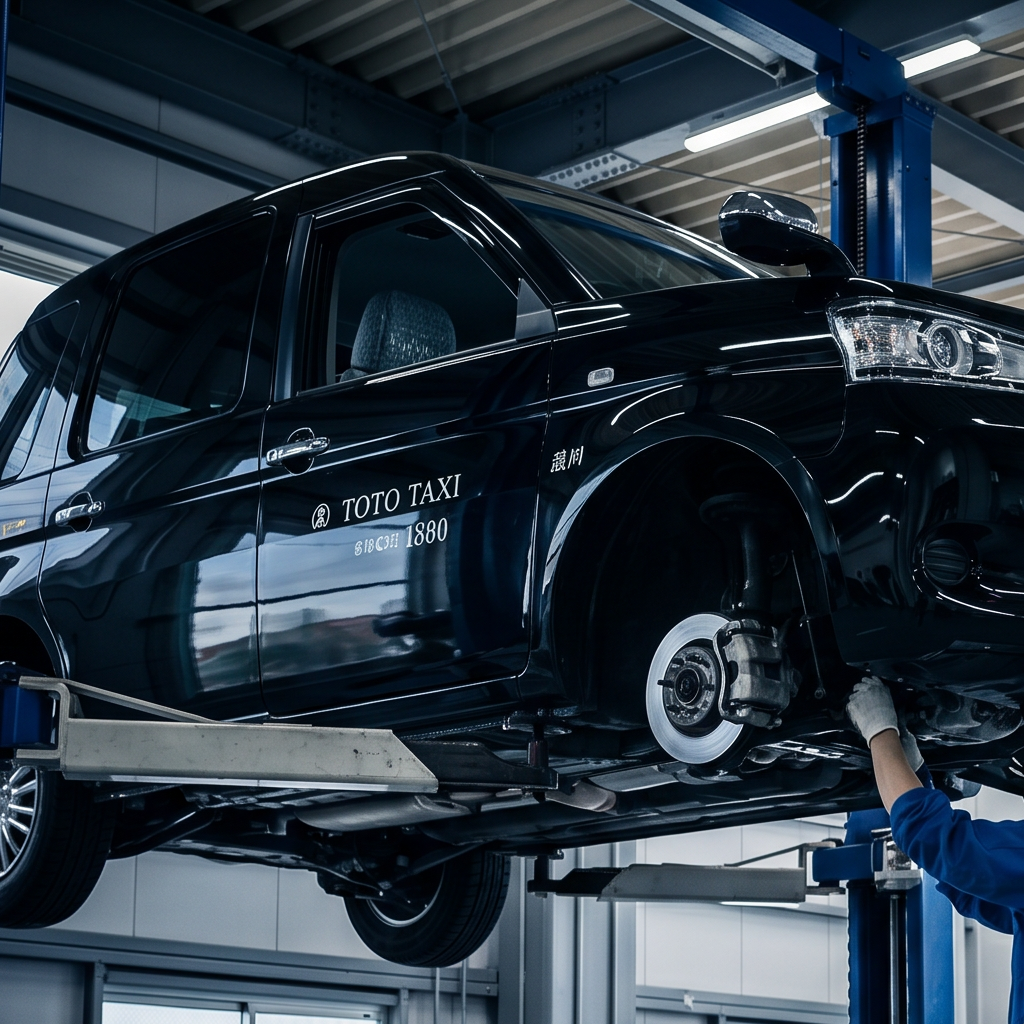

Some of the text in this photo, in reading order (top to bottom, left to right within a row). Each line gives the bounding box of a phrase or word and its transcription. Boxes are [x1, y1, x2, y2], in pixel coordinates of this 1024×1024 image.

[342, 474, 462, 522] TOTO TAXI
[405, 518, 449, 549] 1880
